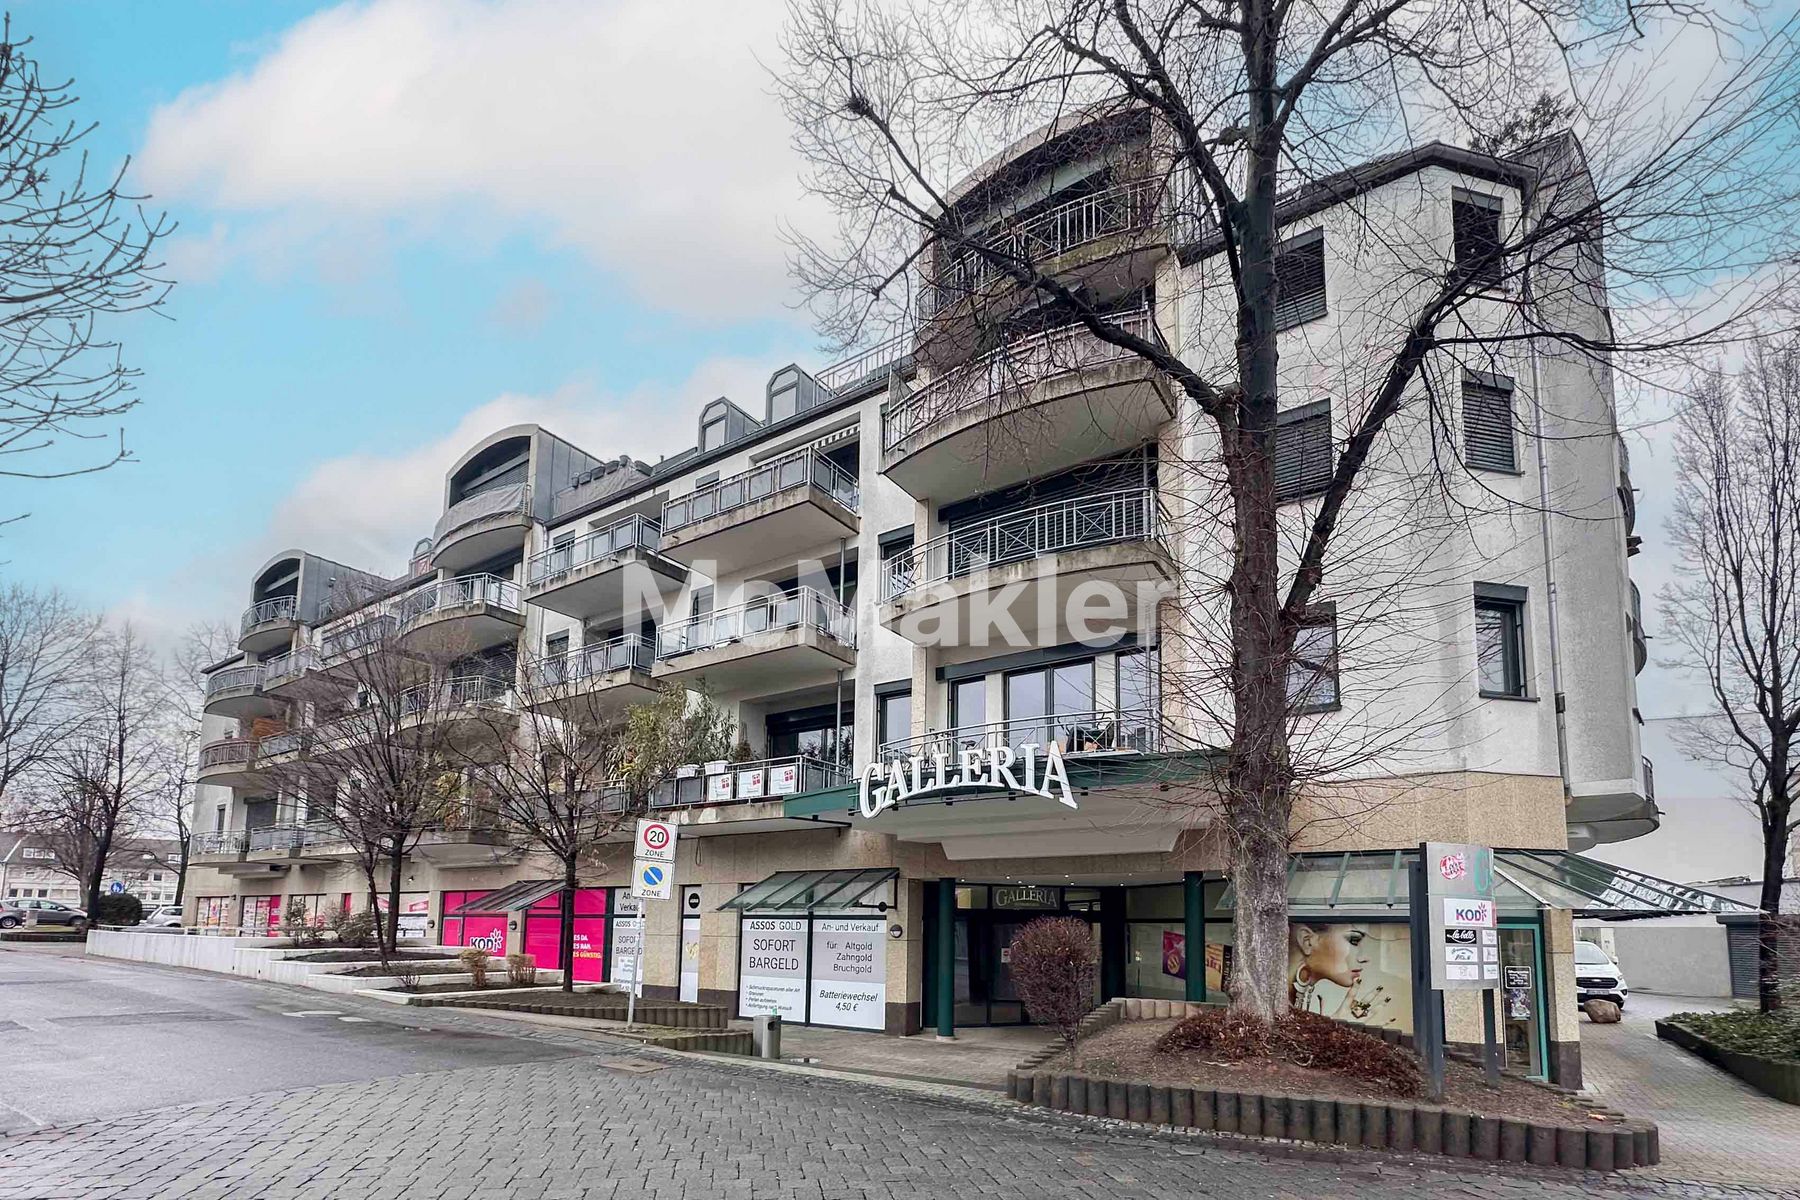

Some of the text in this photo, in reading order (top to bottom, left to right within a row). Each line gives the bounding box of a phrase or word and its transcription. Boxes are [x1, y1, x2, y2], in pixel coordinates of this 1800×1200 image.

[860, 740, 1079, 819] GALLERIA
[649, 830, 665, 843] 20
[645, 849, 665, 857] ZONE
[641, 889, 662, 897] ZONE
[995, 889, 1057, 908] GALLERIA
[750, 921, 802, 931] ASSOS GOLD
[835, 922, 849, 931] und
[850, 922, 879, 932] Verkauf
[616, 946, 643, 956] BARGED
[753, 938, 796, 952] SOFORT
[826, 940, 873, 952] für Altgold
[749, 956, 799, 971] BARGELD
[836, 952, 873, 964] Zahngold
[833, 963, 872, 975] Bruchgold
[819, 989, 878, 1002] Batteriewechsel
[835, 1002, 859, 1012] 4,50 €
